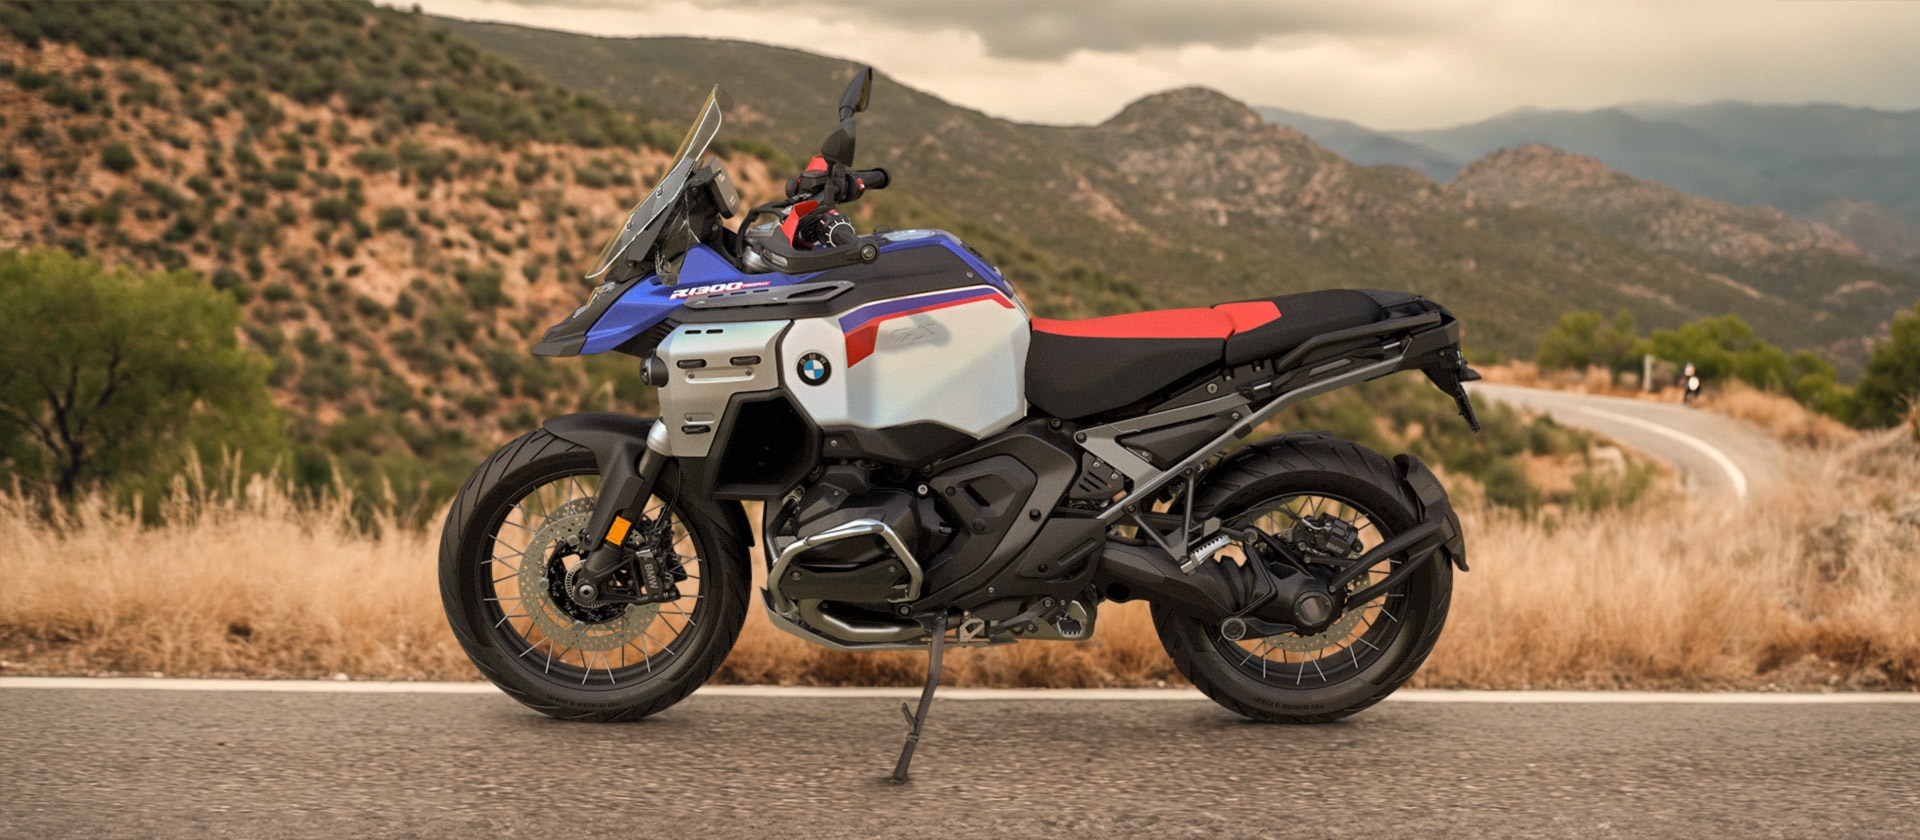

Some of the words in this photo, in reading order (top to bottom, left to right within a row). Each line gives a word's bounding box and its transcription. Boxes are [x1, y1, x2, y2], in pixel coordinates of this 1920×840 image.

[669, 281, 743, 300] R1300
[799, 353, 828, 366] BMW
[1325, 541, 1345, 554] BMW
[644, 563, 659, 589] BMW
